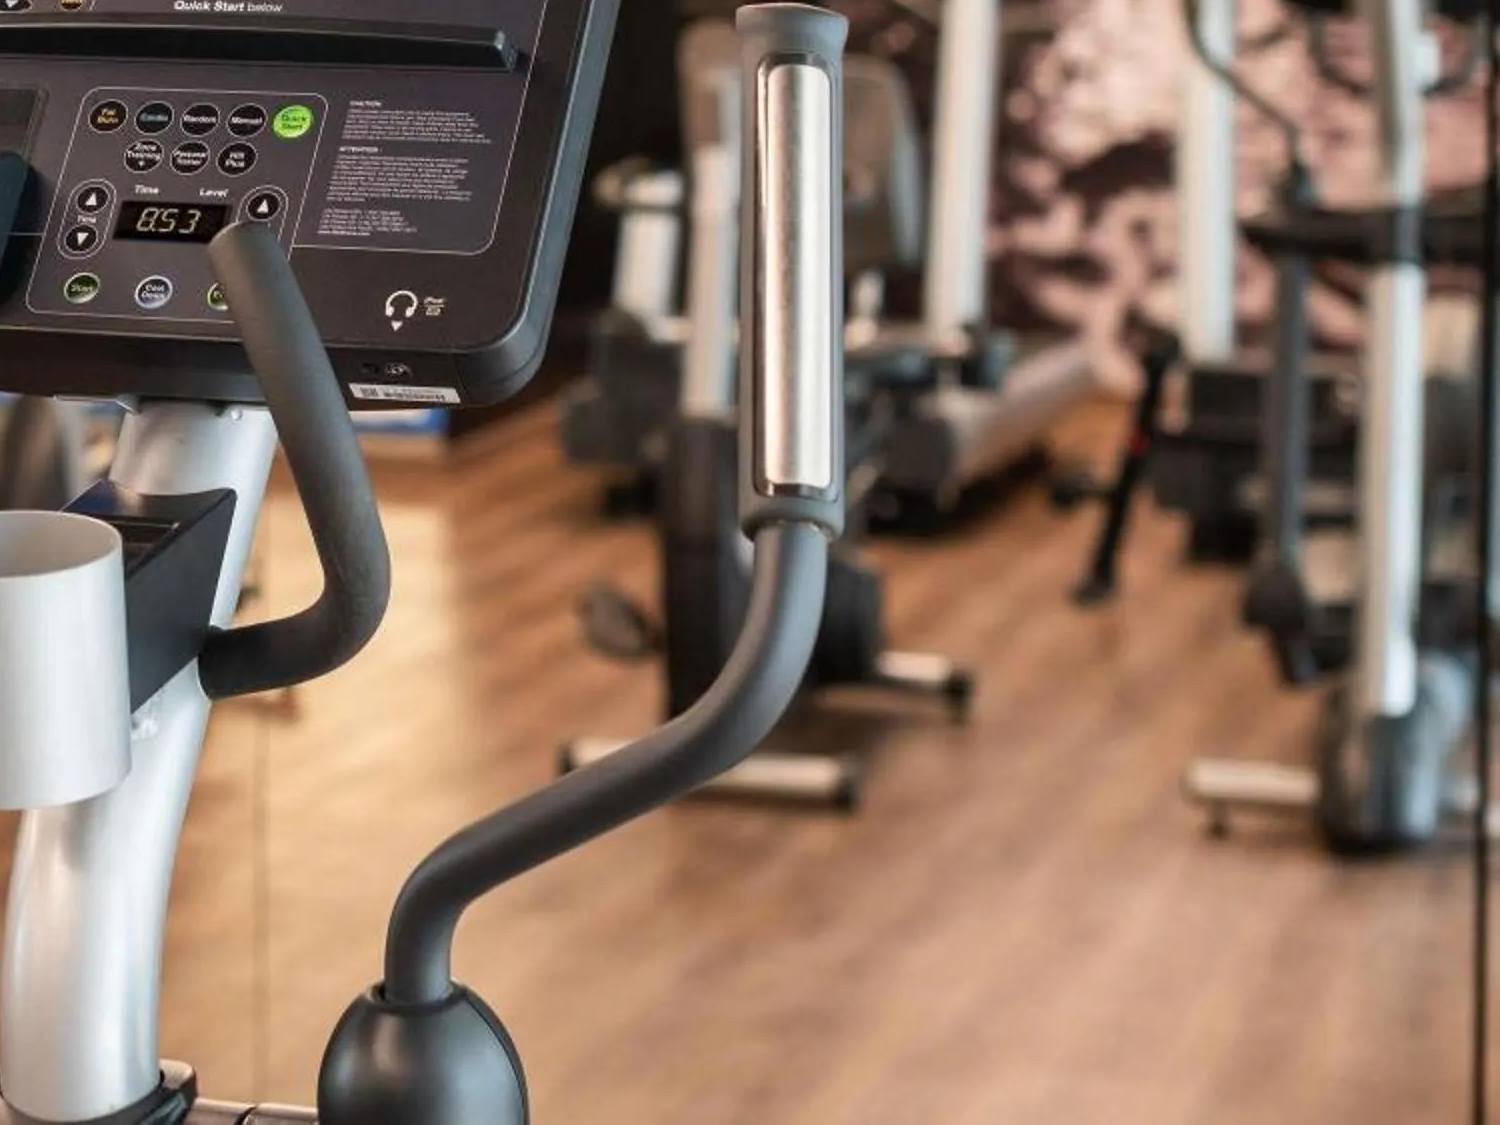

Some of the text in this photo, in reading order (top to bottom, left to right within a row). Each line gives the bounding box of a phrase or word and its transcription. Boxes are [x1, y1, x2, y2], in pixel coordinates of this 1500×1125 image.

[174, 0, 210, 11] Quick
[213, 1, 244, 11] Start
[135, 185, 159, 194] Time
[200, 188, 229, 197] Level
